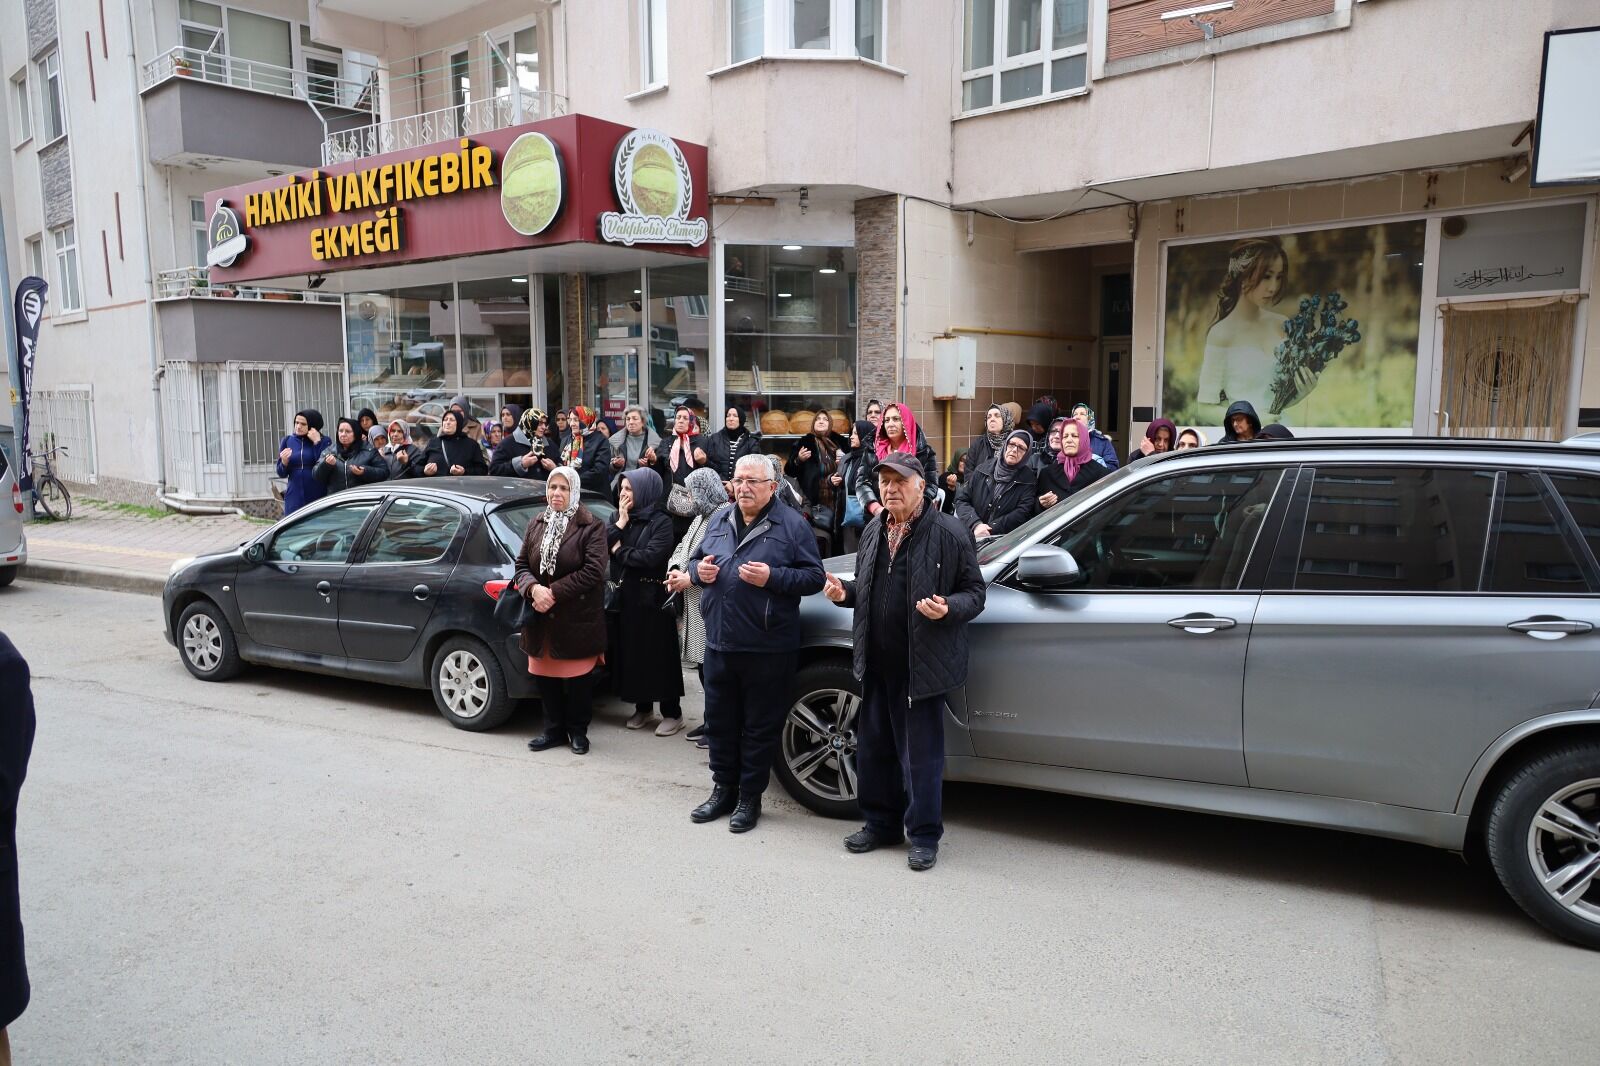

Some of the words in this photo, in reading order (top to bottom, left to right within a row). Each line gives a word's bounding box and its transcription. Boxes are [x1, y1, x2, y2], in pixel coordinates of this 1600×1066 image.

[244, 169, 322, 228] HAKİKİ
[326, 138, 494, 213] VAKFIKEBİR
[310, 207, 400, 261] EKMEĞİ
